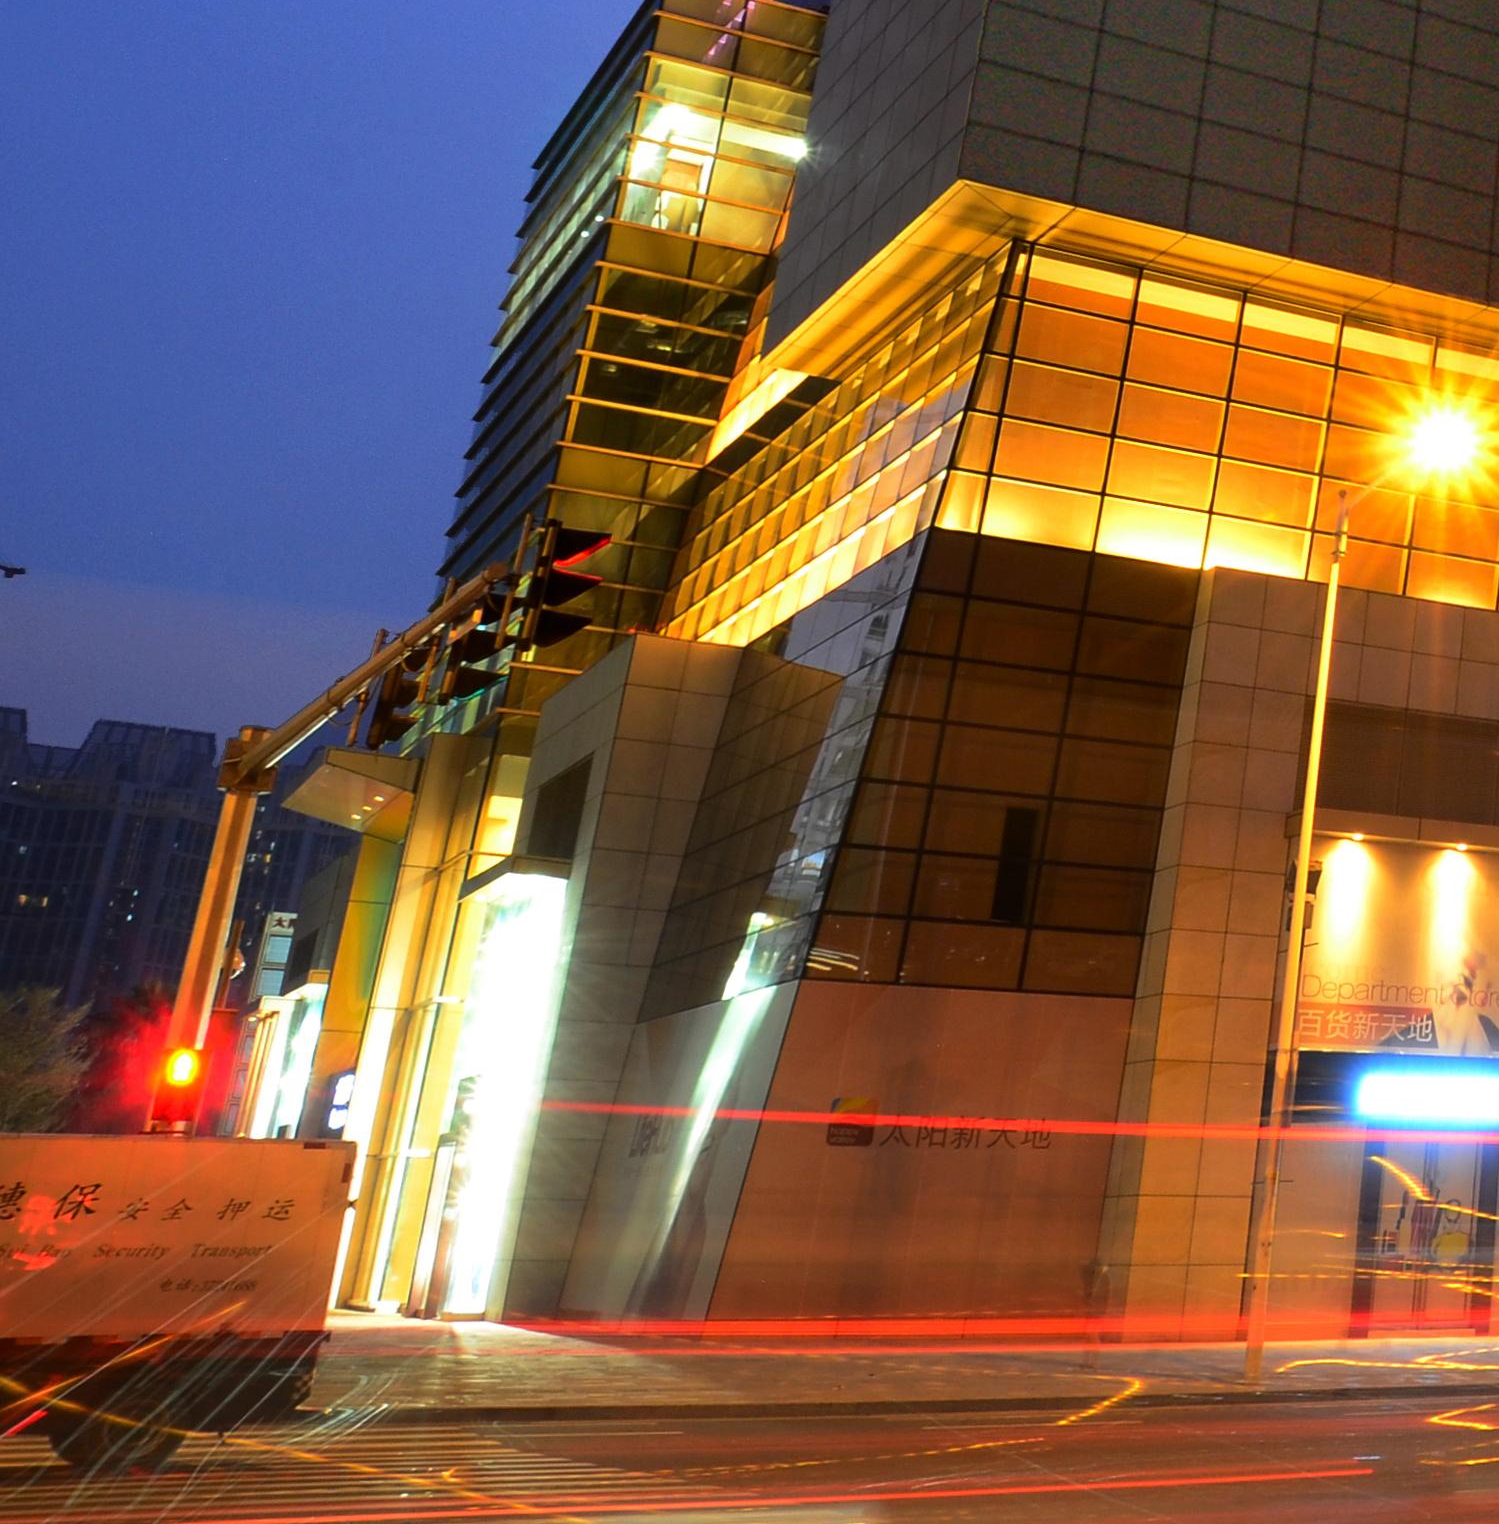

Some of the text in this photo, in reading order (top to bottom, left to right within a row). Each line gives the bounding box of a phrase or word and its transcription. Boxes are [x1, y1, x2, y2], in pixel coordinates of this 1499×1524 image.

[1301, 974, 1446, 1007] Department
[1299, 1007, 1433, 1043] 百货新天地
[119, 1198, 295, 1221] 安全押运
[93, 1243, 169, 1260] Security
[191, 1243, 273, 1260] Transport
